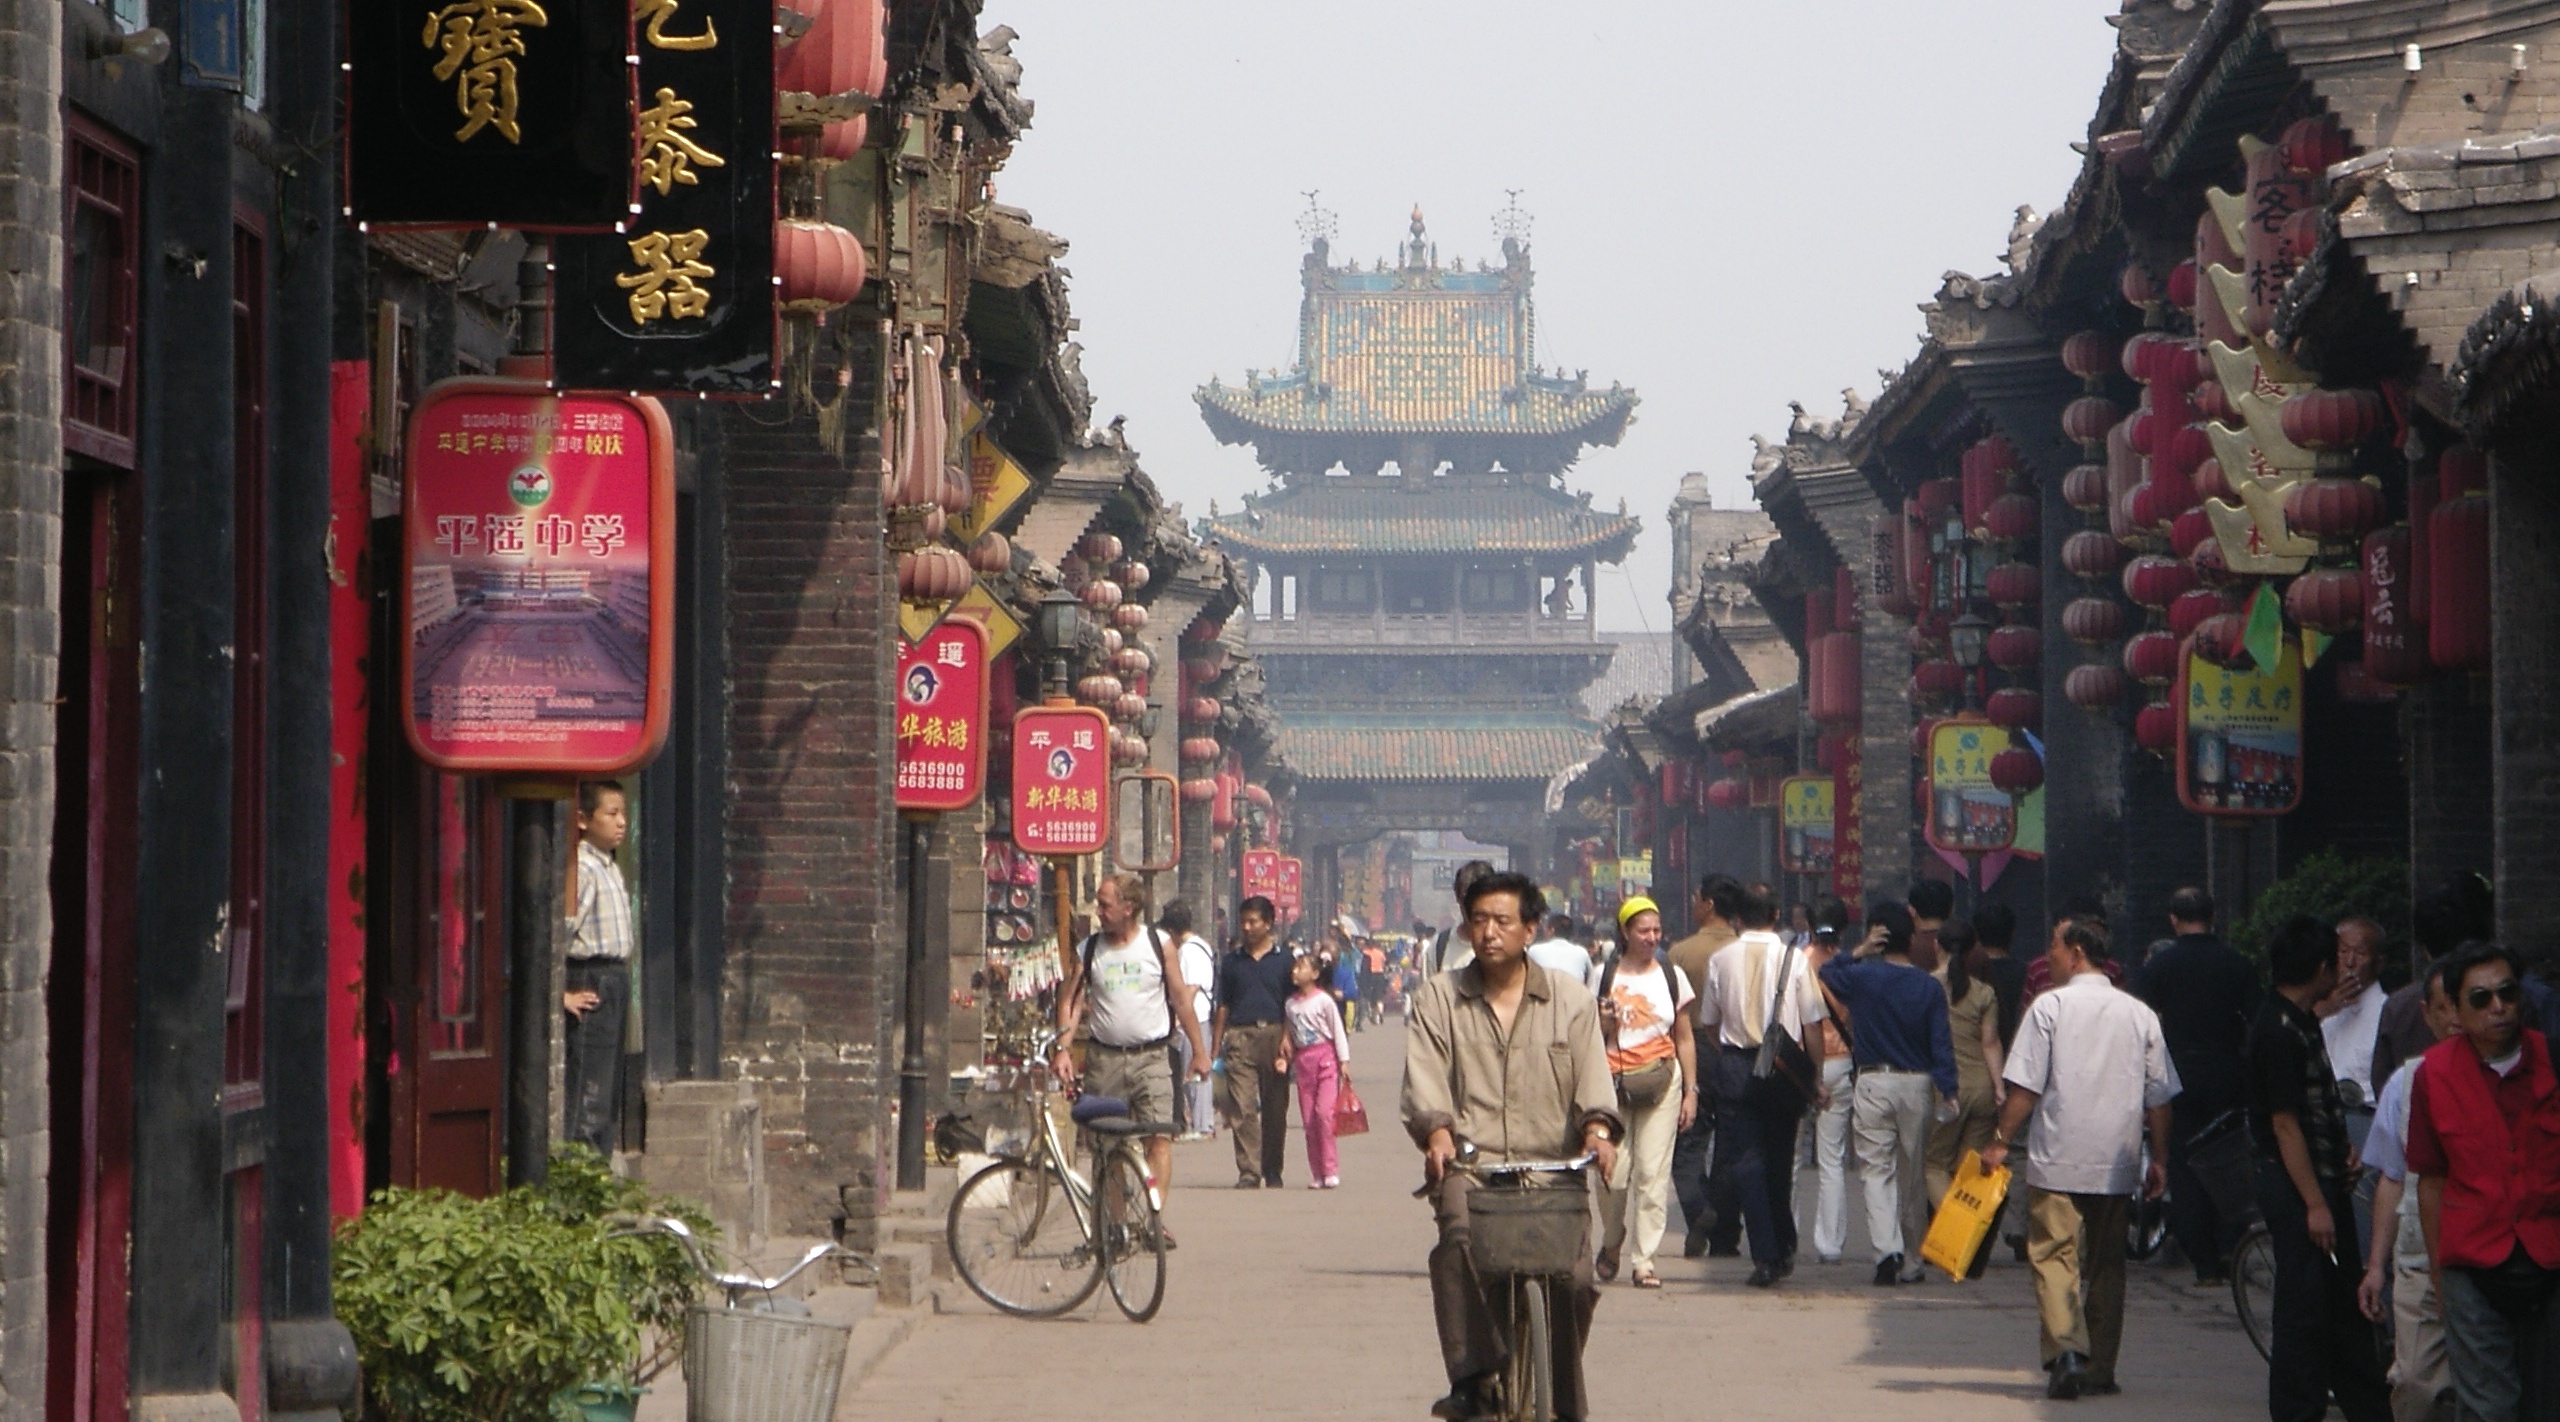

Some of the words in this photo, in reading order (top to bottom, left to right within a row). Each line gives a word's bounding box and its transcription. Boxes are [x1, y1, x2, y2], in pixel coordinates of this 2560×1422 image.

[435, 513, 625, 559] 平遥中学
[897, 641, 967, 669] 遥
[898, 712, 969, 752] 华旅游
[899, 761, 965, 775] 5636900
[899, 775, 965, 791] 5683888
[1025, 785, 1099, 814] 新华旅游
[1046, 821, 1097, 833] 5636900
[1046, 832, 1097, 844] 5683888
